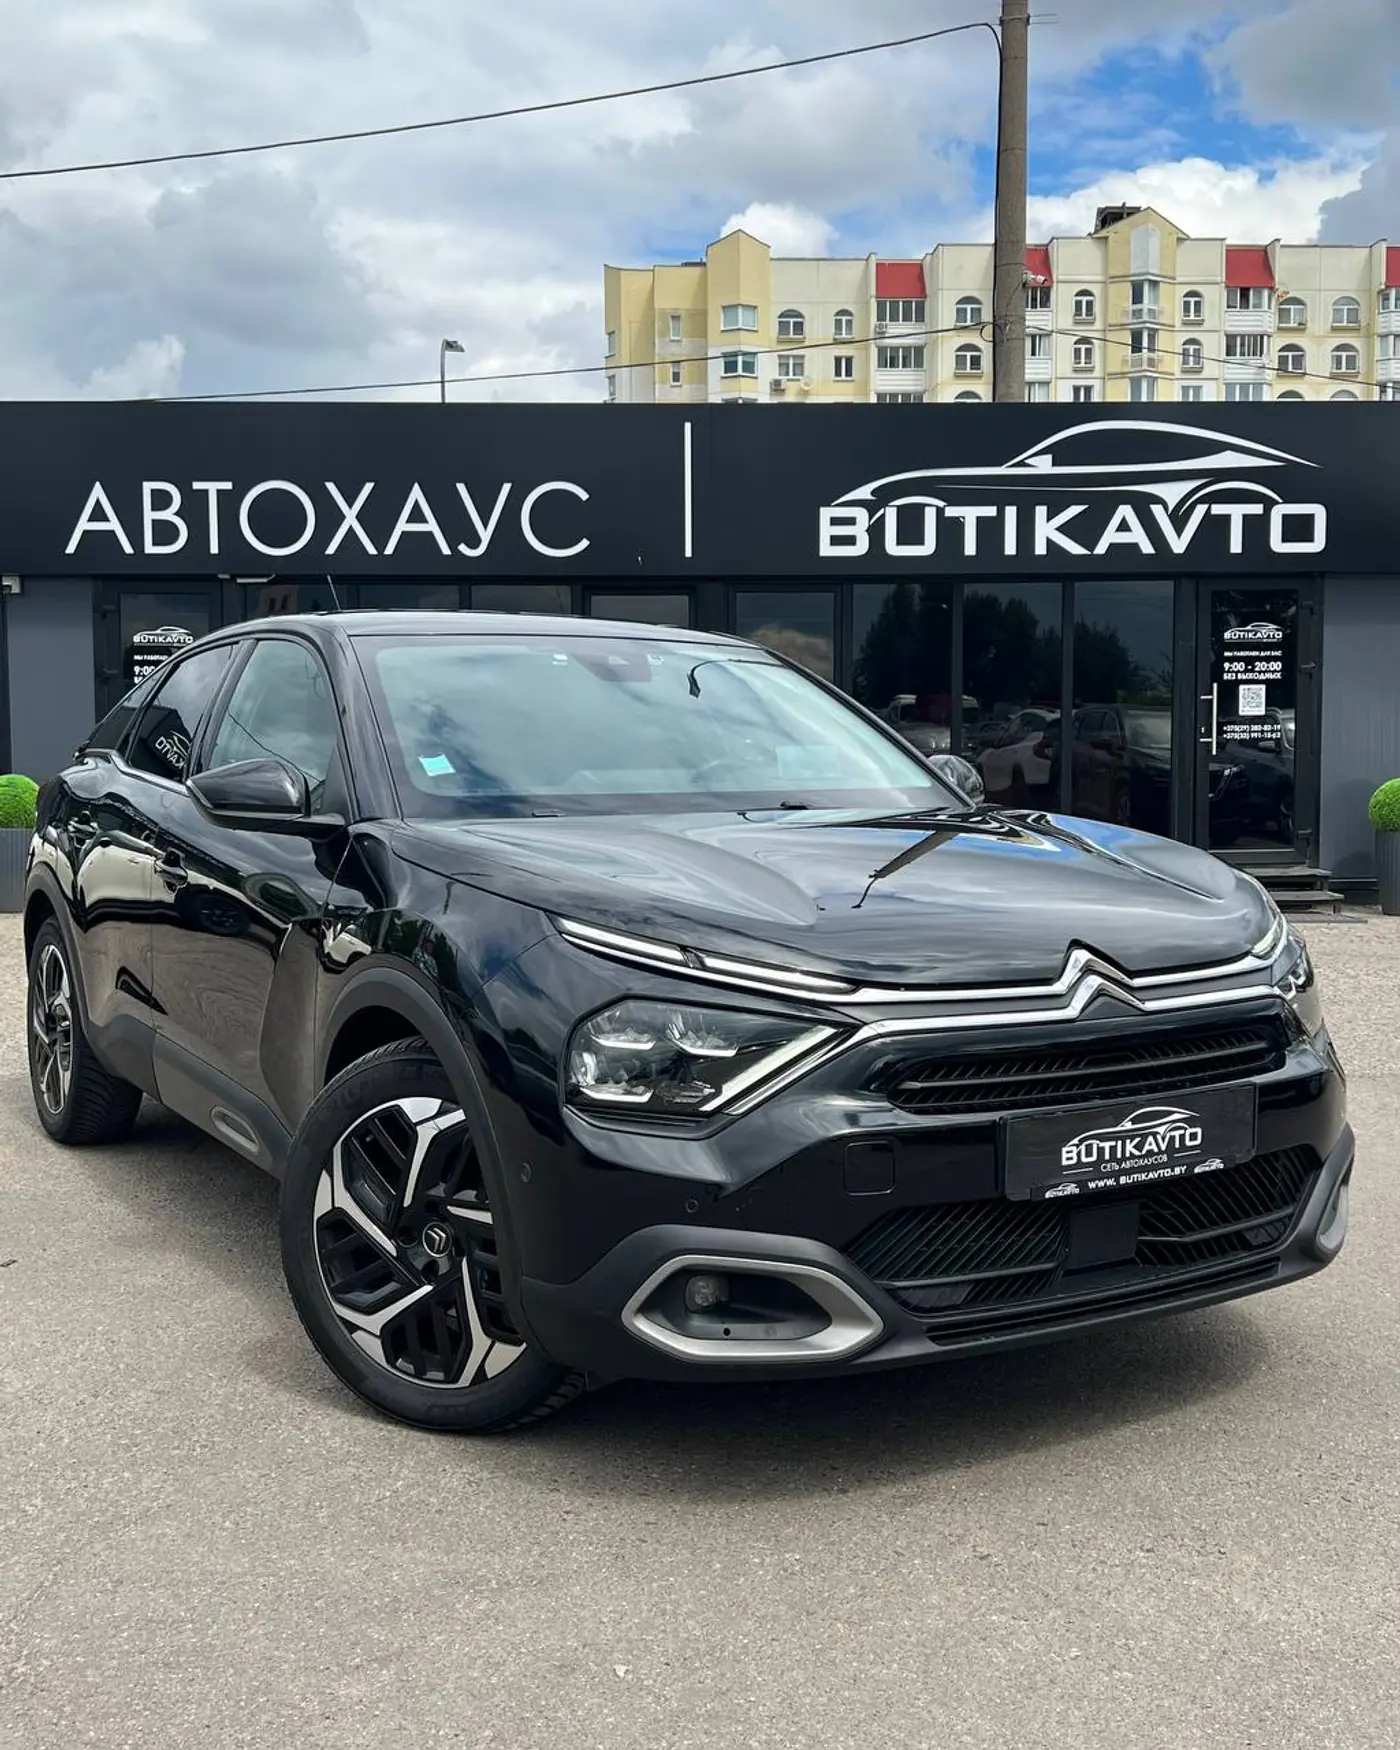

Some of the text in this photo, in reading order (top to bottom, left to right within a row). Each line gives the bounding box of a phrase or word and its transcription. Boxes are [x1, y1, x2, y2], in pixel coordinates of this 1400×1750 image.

[65, 480, 591, 558] АВТОХАУС
[819, 502, 1327, 557] BUTIKAVTO
[132, 634, 194, 644] BUTIKAVTO
[1223, 631, 1283, 639] BUTIKAVTO
[1223, 662, 1245, 672] 9:00
[1254, 661, 1282, 671] 20:00
[1223, 672, 1282, 680] БЕЗ ВЫХОДНЫХ
[1061, 1127, 1203, 1166] BUTIKAVTO
[1100, 1154, 1168, 1172] СЕТЬ АВТОХАУСОВ
[1119, 1165, 1187, 1184] BUTIKAVTO.BY
